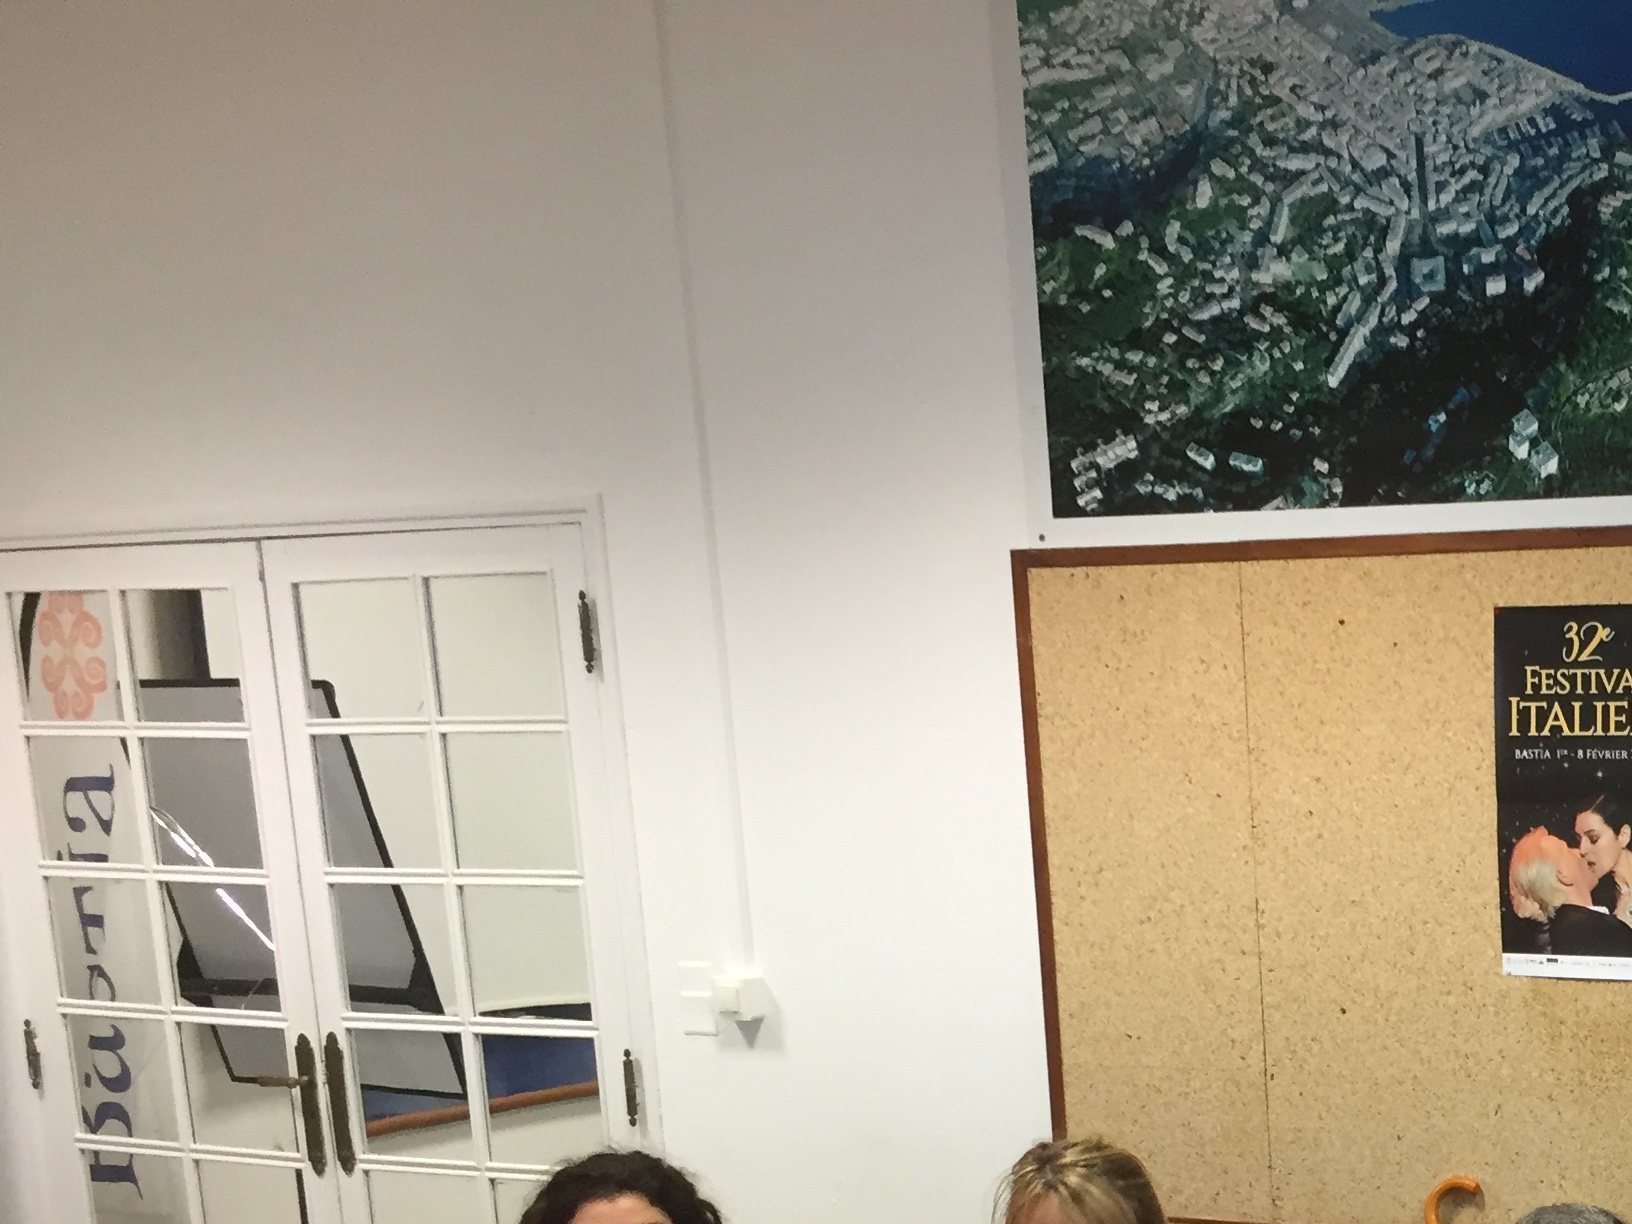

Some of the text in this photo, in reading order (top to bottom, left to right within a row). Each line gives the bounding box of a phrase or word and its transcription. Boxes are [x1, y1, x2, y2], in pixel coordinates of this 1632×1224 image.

[1514, 748, 1551, 760] BASTIA
[1577, 748, 1584, 760] 8
[1586, 746, 1629, 760] FÉVRIER
